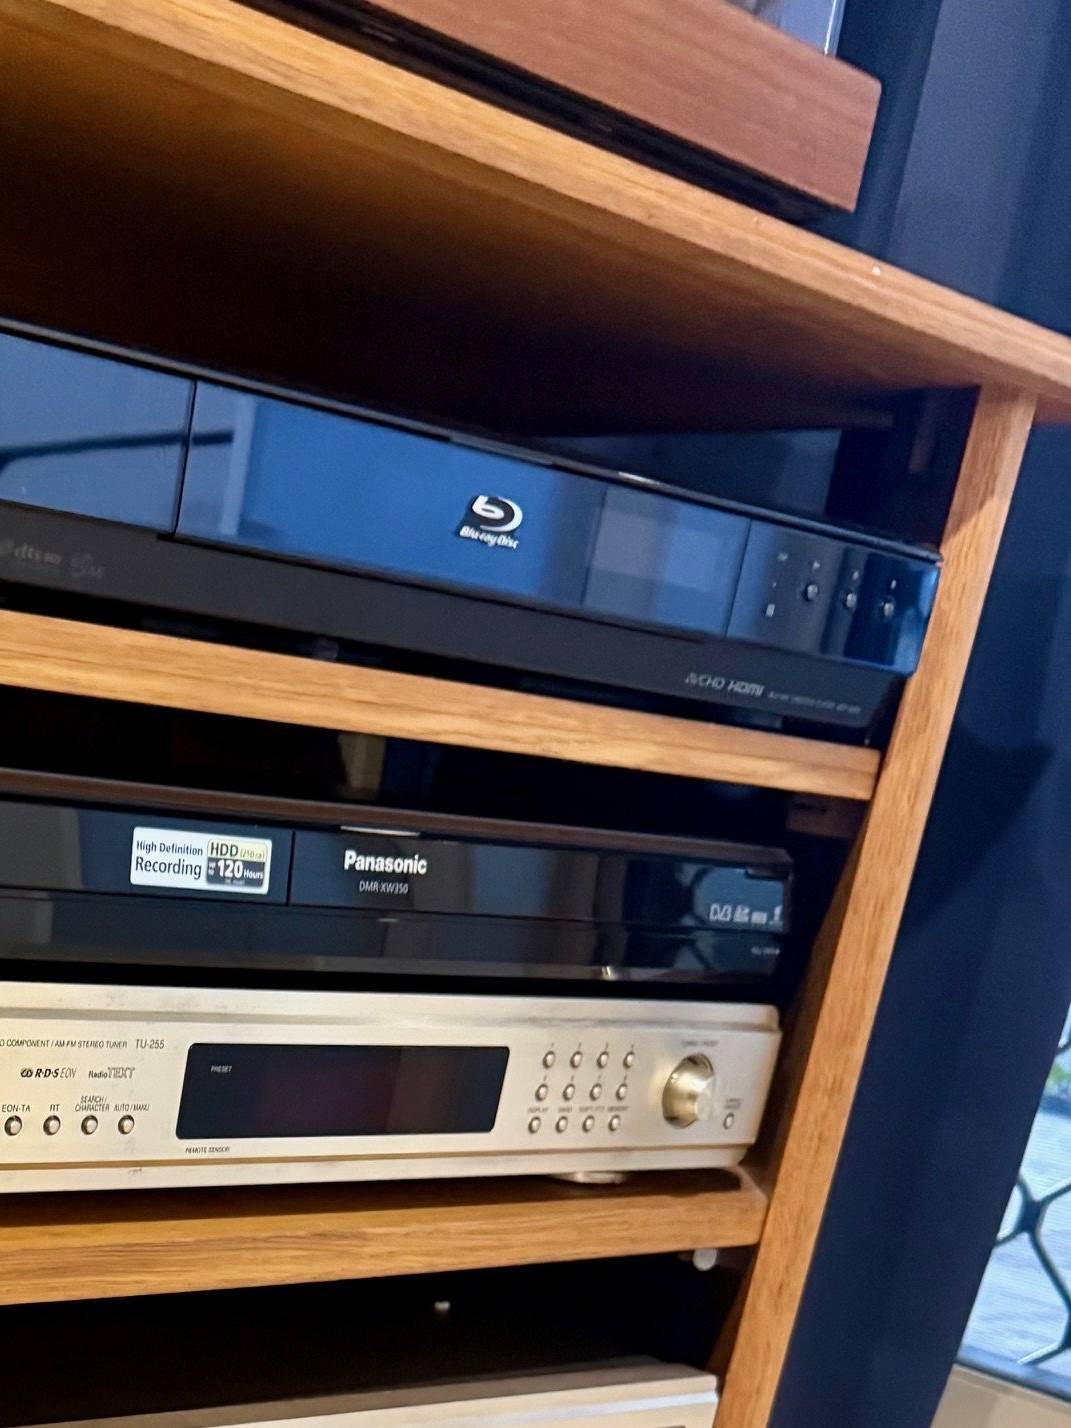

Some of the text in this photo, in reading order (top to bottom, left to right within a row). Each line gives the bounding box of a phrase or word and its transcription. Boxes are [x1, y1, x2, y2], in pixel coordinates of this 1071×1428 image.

[459, 525, 520, 549] Blu-ray Disc
[728, 680, 765, 697] HDMI
[136, 840, 203, 856] High Definition
[210, 842, 239, 857] HDD
[135, 856, 202, 880] Recording
[344, 849, 427, 875] Panasonic
[217, 860, 264, 880] 120 Hours
[6, 1039, 50, 1048] COMPONENT
[77, 1040, 104, 1049] STEREO
[106, 1041, 128, 1049] TUNER
[210, 1065, 232, 1073] PRESET
[80, 1095, 103, 1104] SEARCH
[75, 1103, 109, 1112] CHARACTER
[185, 1146, 207, 1154] REMOTE
